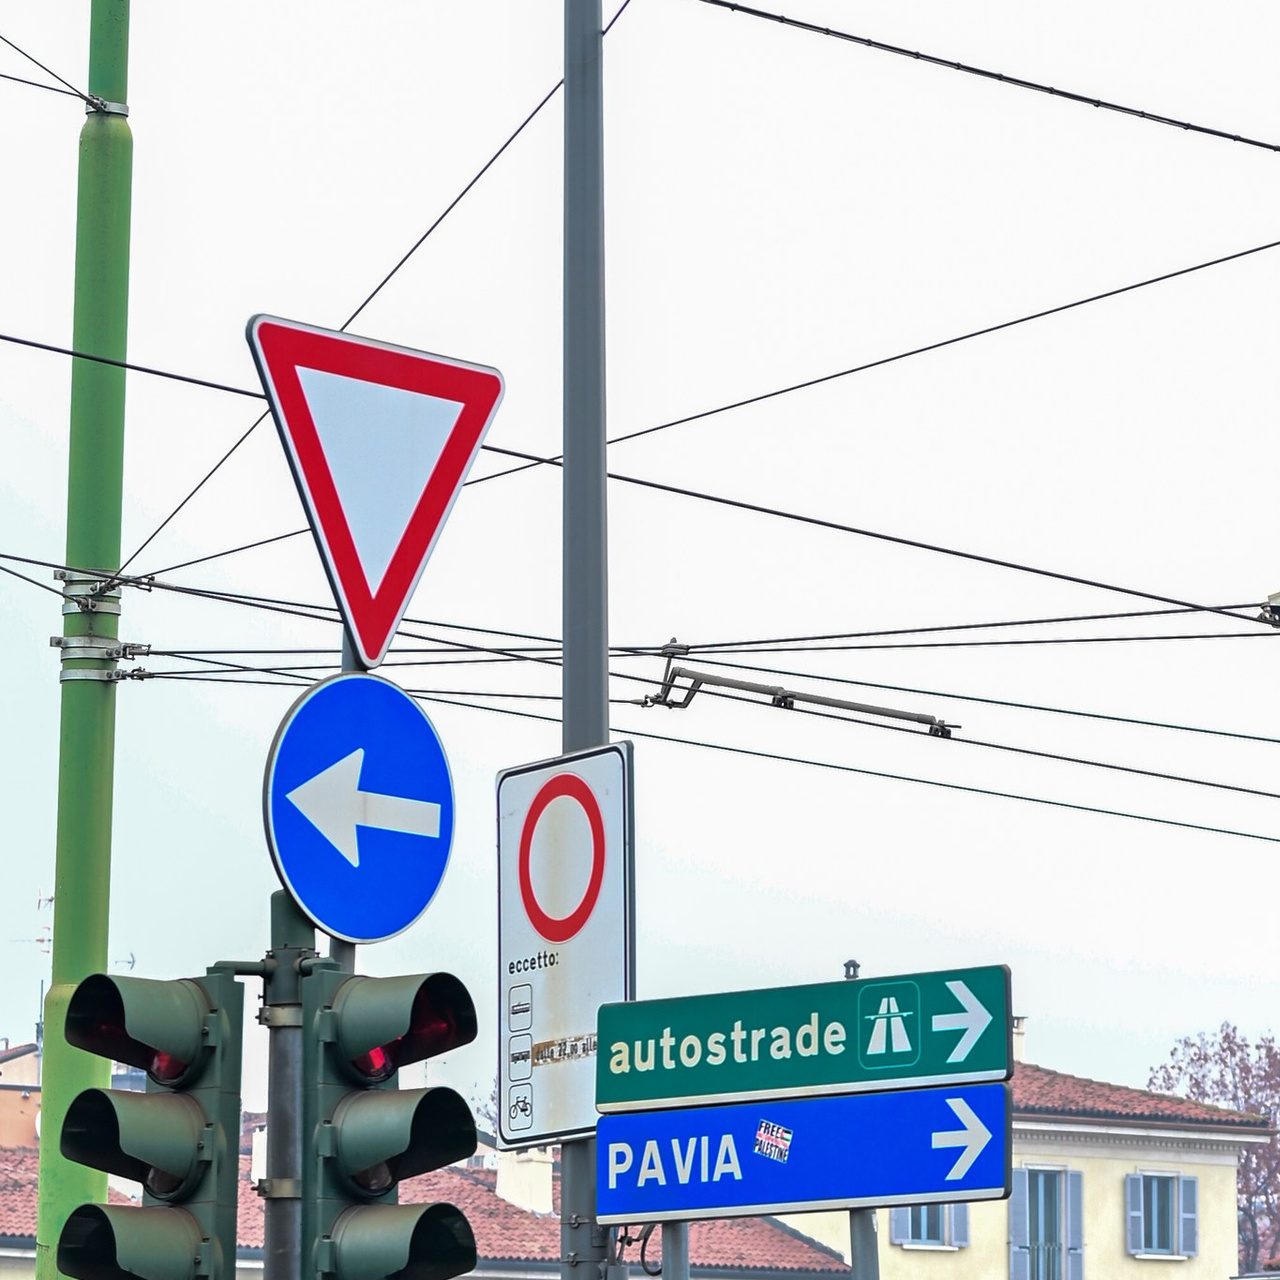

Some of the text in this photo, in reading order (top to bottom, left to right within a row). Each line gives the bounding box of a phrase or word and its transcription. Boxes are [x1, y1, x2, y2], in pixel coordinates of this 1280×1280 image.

[508, 951, 559, 974] eccetto:
[609, 1012, 847, 1074] autostrade
[759, 1121, 783, 1139] FREE
[608, 1134, 743, 1189] PAVIA
[755, 1138, 789, 1162] PALESTINE
